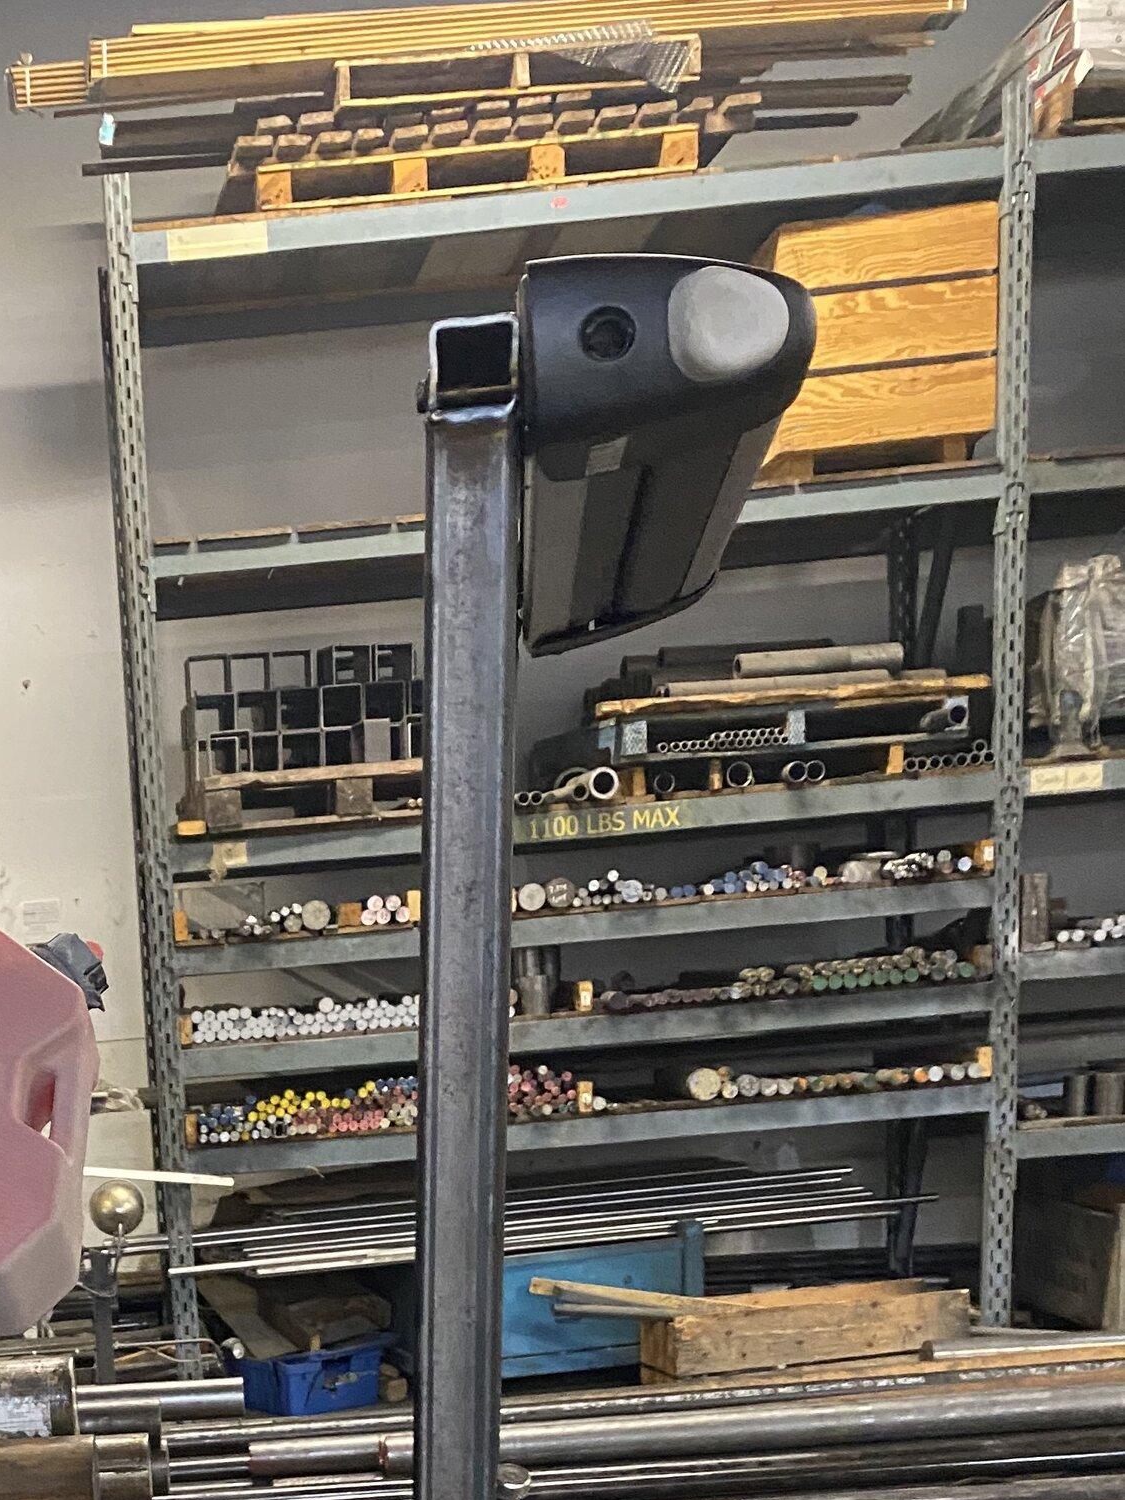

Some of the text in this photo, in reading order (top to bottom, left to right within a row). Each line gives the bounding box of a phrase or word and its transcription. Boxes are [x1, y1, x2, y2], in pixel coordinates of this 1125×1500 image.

[529, 805, 681, 839] 1100 LBS MAX
